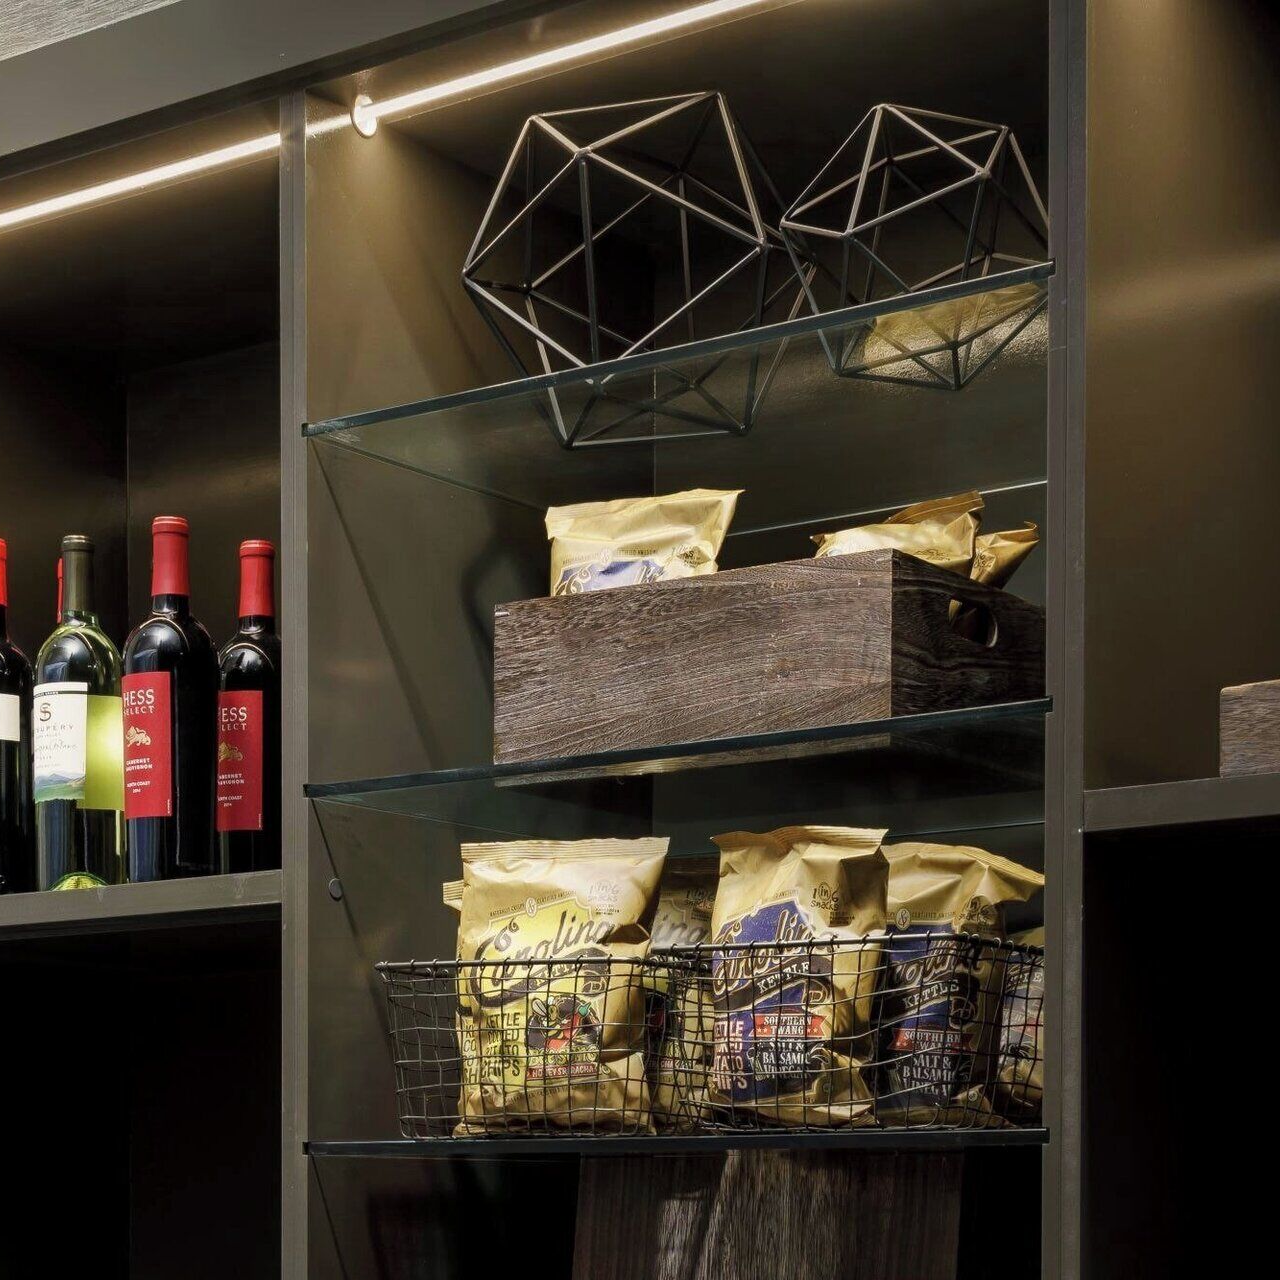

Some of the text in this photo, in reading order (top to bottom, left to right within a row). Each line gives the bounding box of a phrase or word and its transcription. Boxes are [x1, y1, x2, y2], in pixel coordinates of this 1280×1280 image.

[123, 688, 155, 707] HESS
[903, 980, 960, 1009] KETTLE
[763, 1015, 812, 1026] SOUTHERN
[770, 1025, 804, 1035] TWANG
